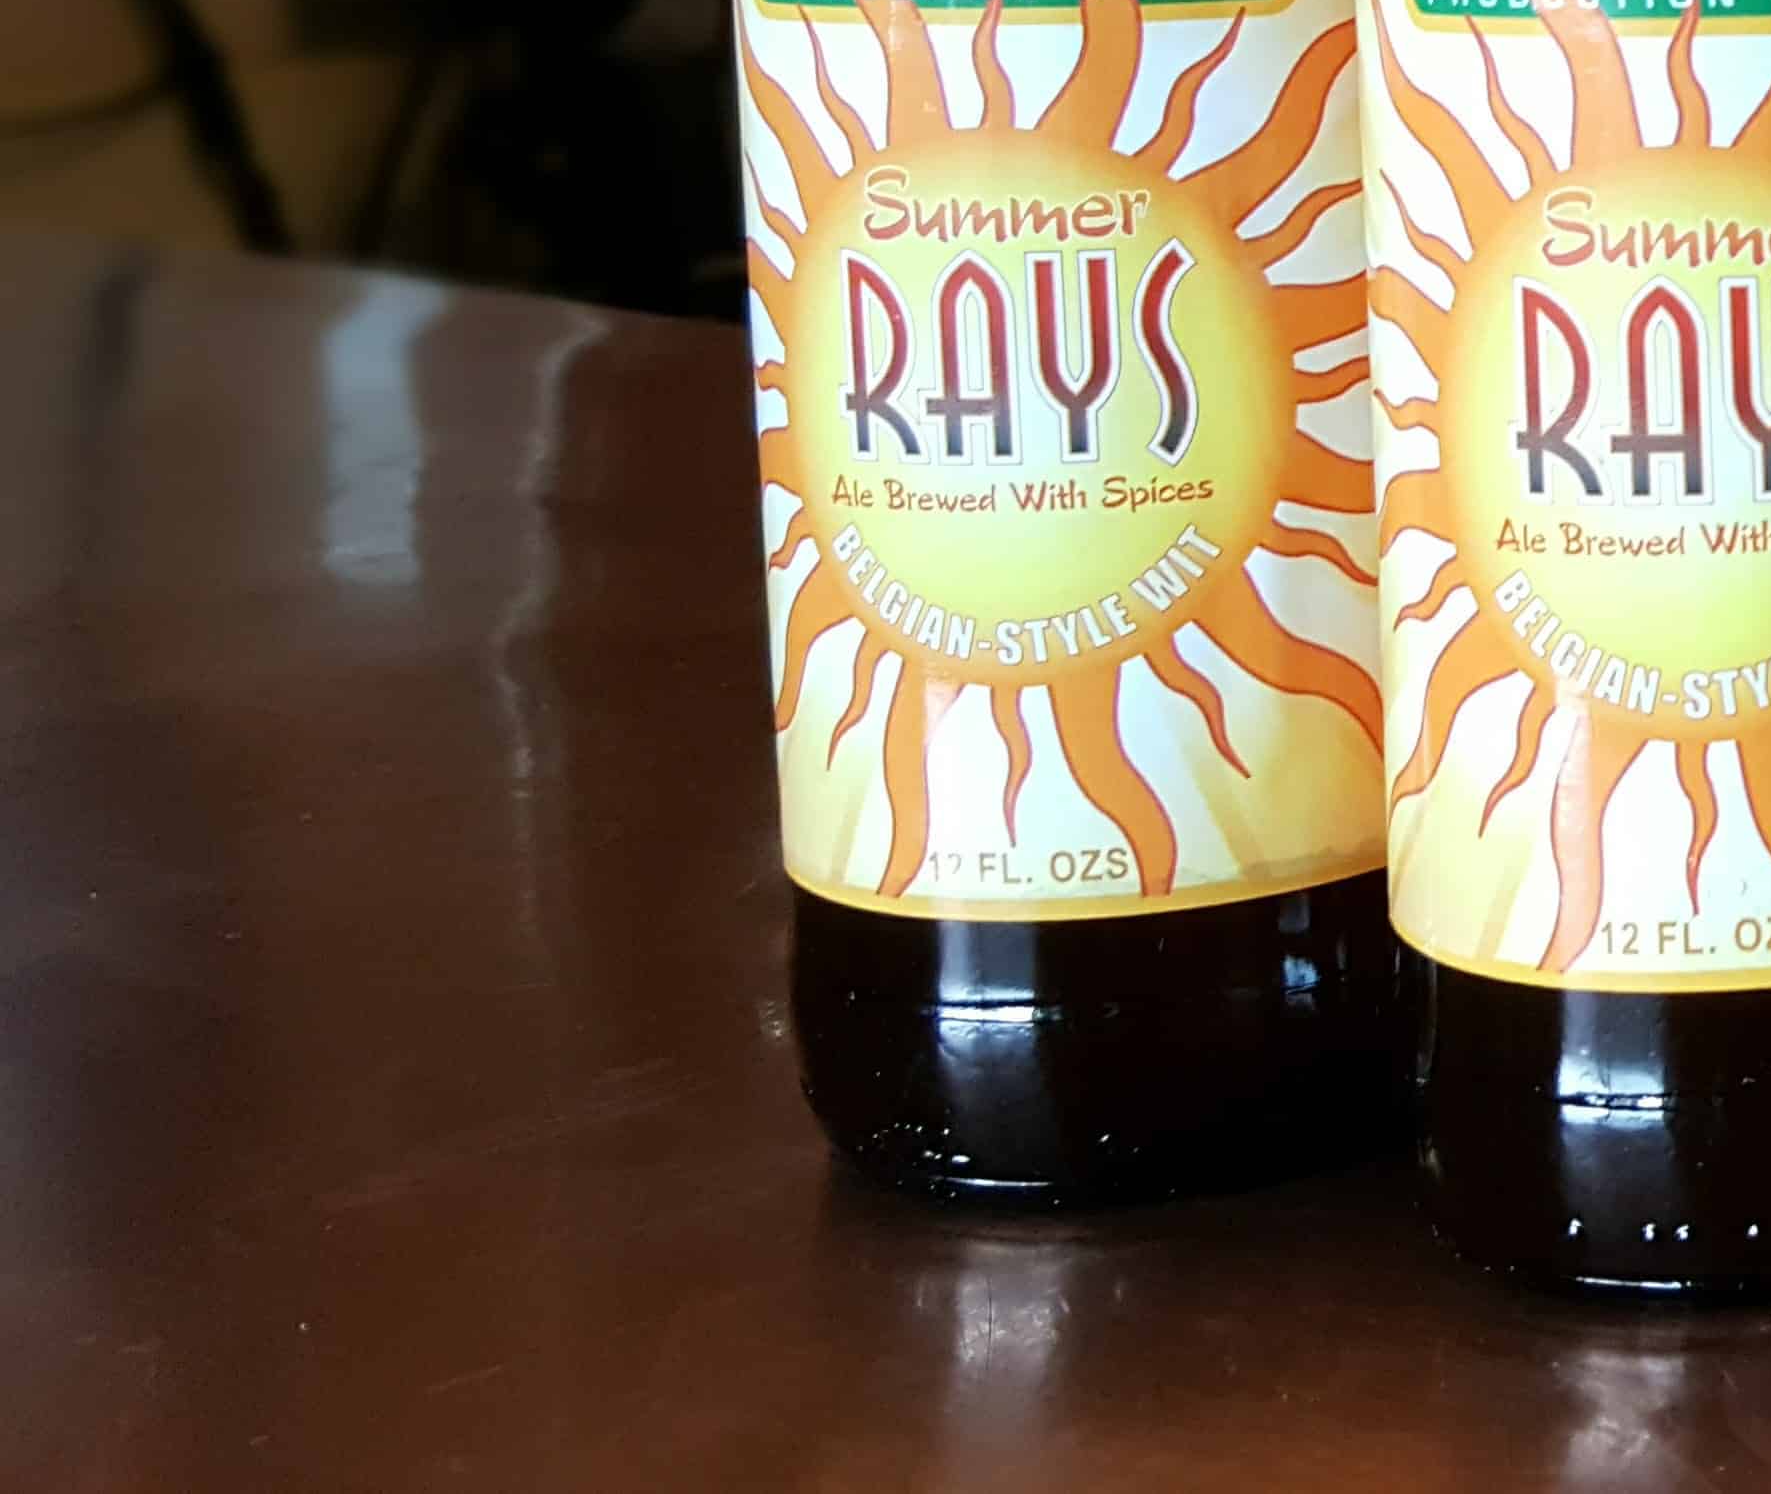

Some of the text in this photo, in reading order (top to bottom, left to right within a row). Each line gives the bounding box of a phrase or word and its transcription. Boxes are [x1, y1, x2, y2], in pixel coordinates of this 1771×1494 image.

[863, 167, 1150, 243] Summer
[843, 243, 1195, 461] RAYS
[832, 473, 1215, 513] Ale Brewed With Spices
[1495, 516, 1547, 554] Ale
[1558, 520, 1686, 557] Brewed
[832, 521, 1222, 666] BELGIAN-STYLE WIT
[978, 851, 1033, 884] FL.
[1049, 847, 1129, 883] OZS
[1601, 921, 1639, 955] 12
[1657, 920, 1716, 955] FL.
